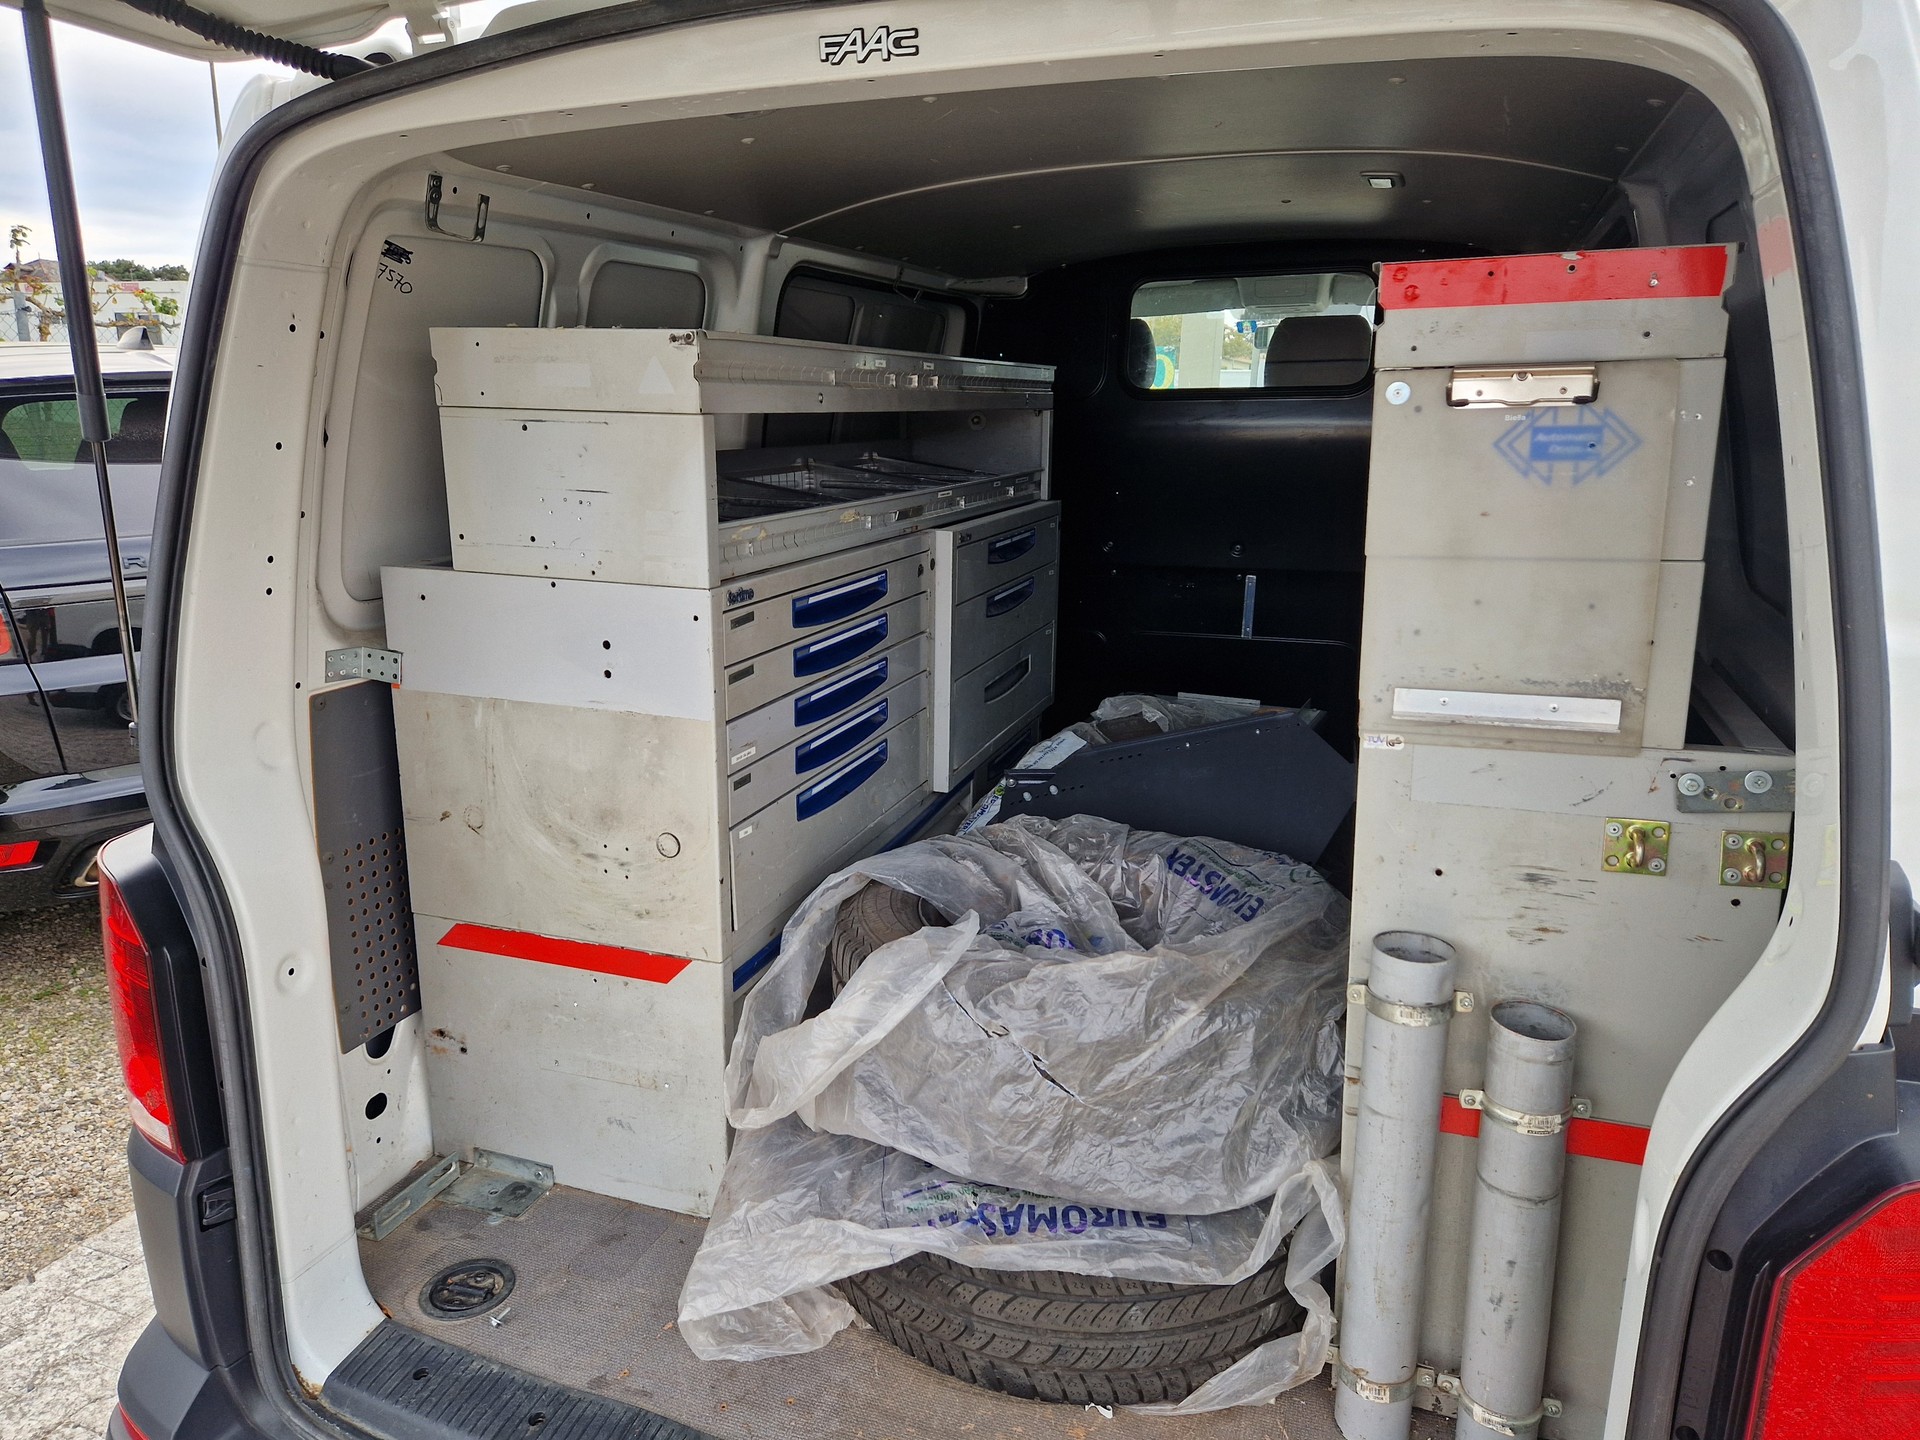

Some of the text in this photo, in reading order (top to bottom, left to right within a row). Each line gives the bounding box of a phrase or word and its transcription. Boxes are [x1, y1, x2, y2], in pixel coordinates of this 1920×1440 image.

[819, 26, 919, 65] FAAC
[378, 262, 413, 294] 7570
[912, 1202, 1167, 1237] EUROMAS
